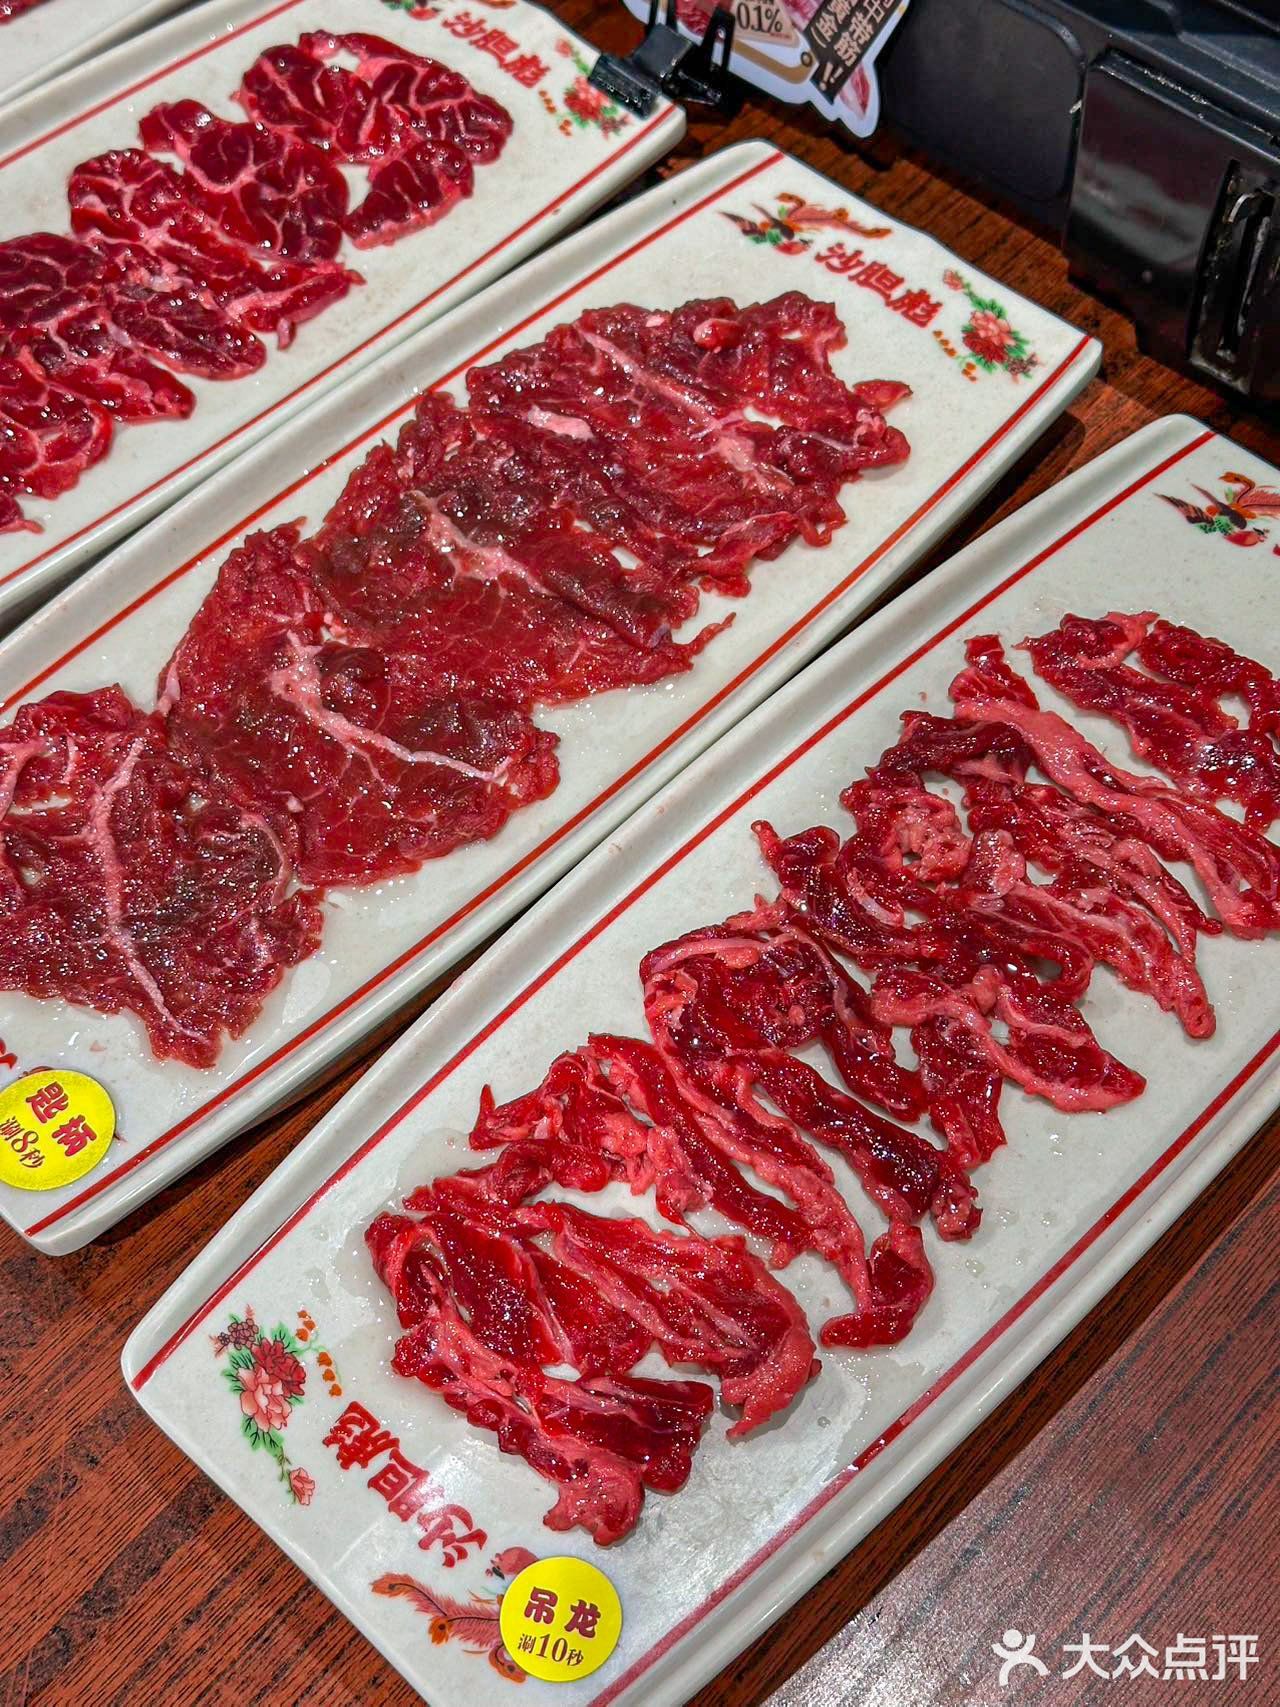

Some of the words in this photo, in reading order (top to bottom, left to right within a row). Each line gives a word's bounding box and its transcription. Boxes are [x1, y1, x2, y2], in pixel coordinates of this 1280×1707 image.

[441, 11, 550, 88] 沙胆彪
[736, 2, 783, 33] 0.1%
[815, 243, 943, 328] 沙胆彪
[0, 1116, 46, 1168] 涮8秒
[26, 1081, 97, 1157] 匙柄
[322, 1401, 488, 1568] 沙胆彪
[524, 1586, 602, 1639] 吊龙
[518, 1633, 584, 1667] 涮10秒
